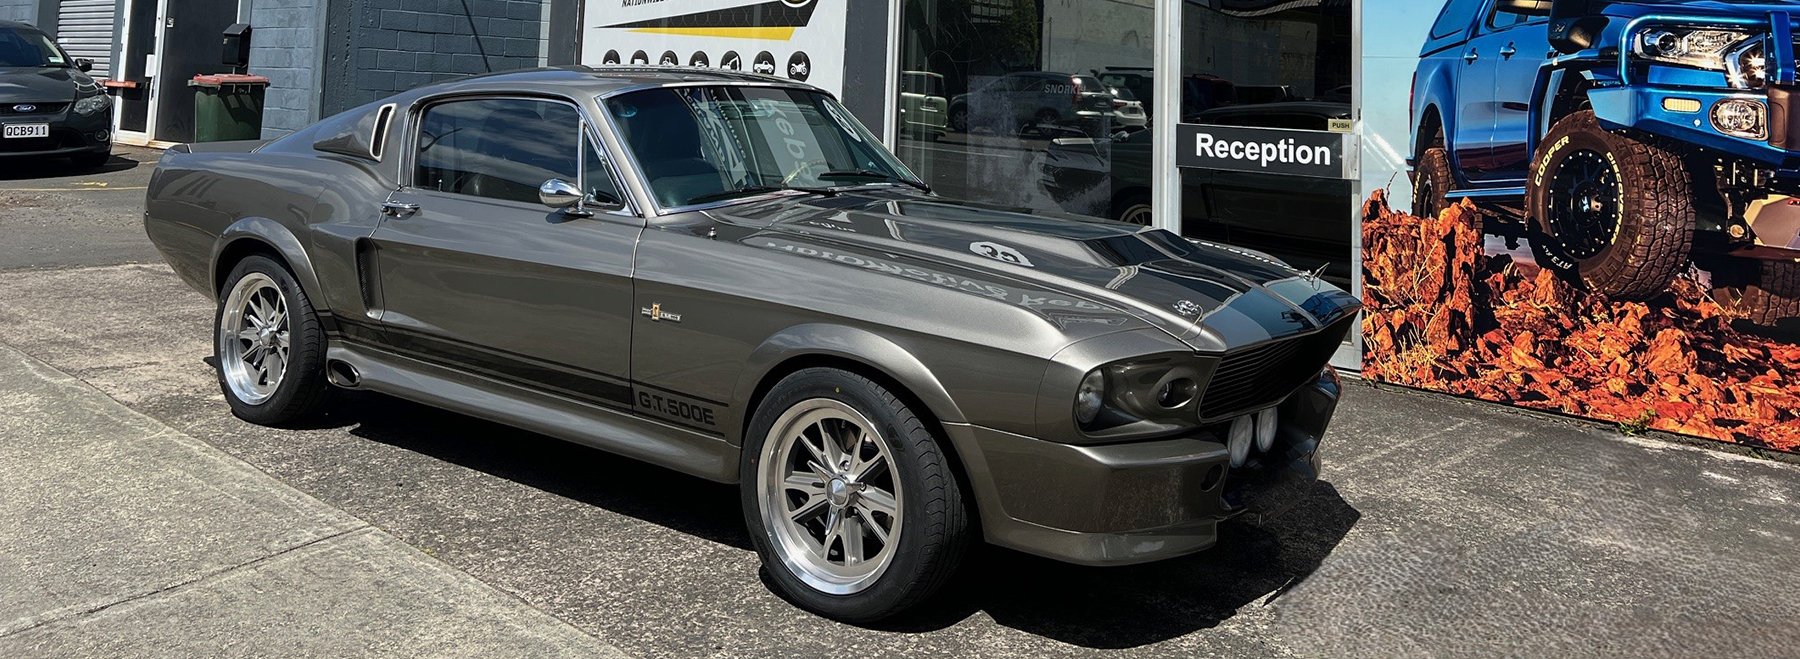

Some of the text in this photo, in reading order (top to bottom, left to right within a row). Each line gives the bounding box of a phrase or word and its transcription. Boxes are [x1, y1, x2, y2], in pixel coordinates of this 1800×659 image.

[6, 126, 46, 136] QCB911
[1196, 133, 1331, 167] Reception
[1534, 134, 1570, 187] COOPER
[1605, 151, 1625, 246] DISCOVERER
[1551, 256, 1573, 270] AT3
[638, 391, 716, 426] G.T.500E
